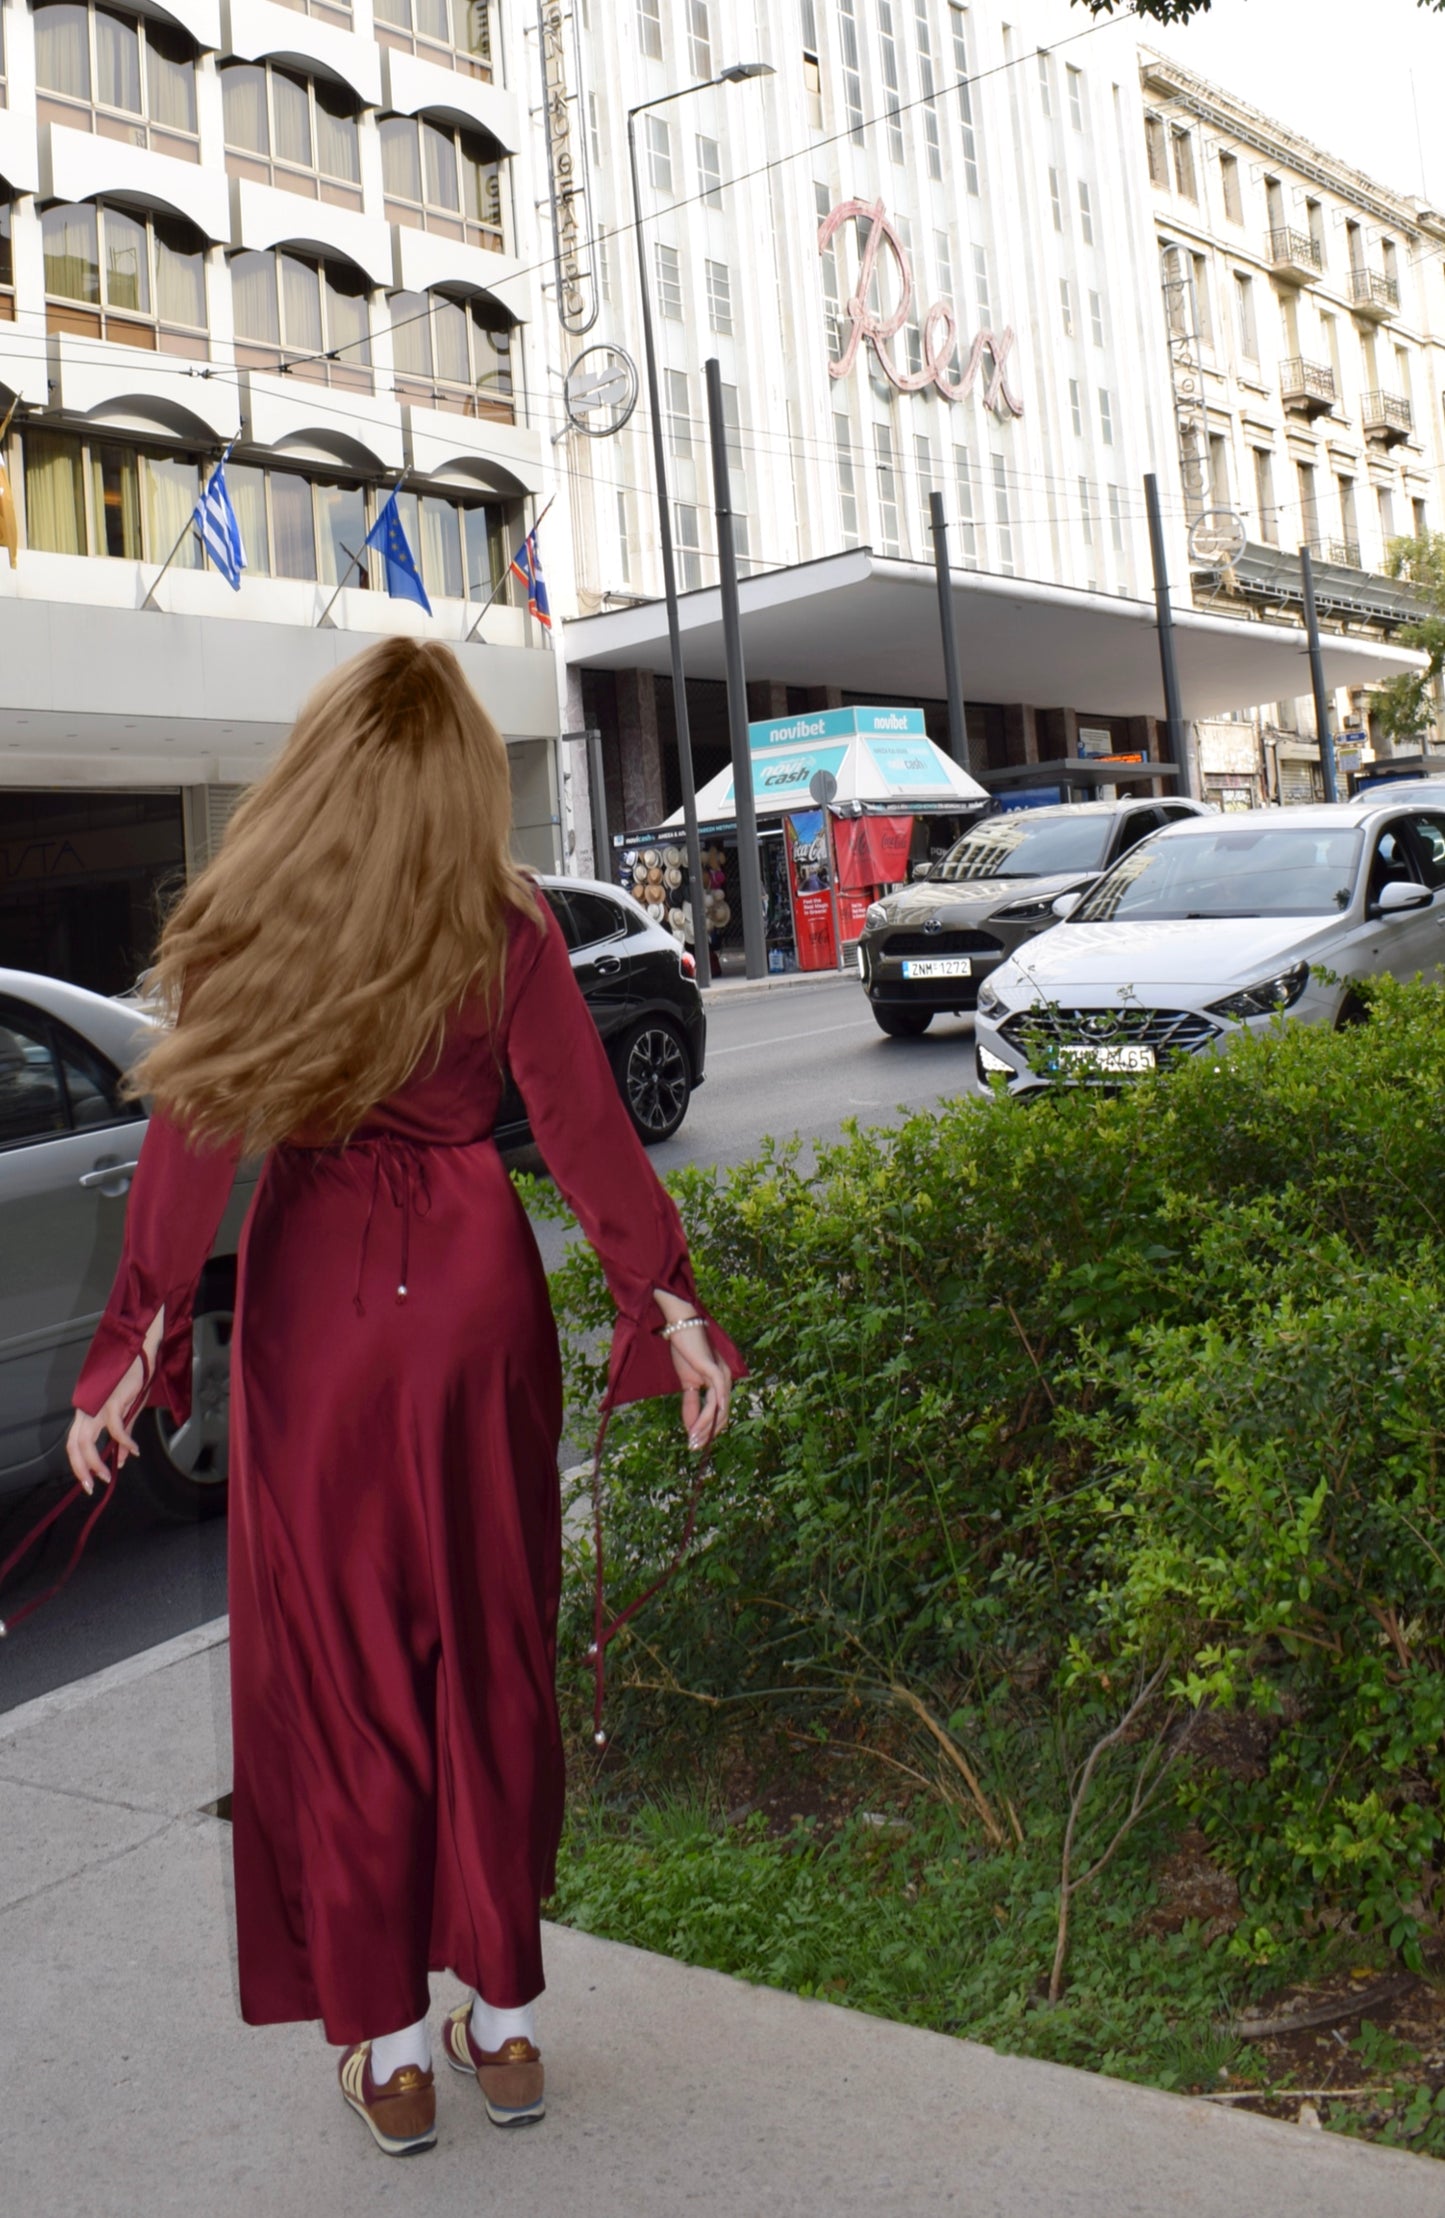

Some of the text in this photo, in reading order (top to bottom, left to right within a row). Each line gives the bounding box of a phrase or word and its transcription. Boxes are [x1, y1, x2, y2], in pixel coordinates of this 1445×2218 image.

[817, 196, 1024, 416] Rex
[769, 719, 826, 743] novibet
[873, 713, 908, 730] novibet
[764, 767, 810, 787] cash
